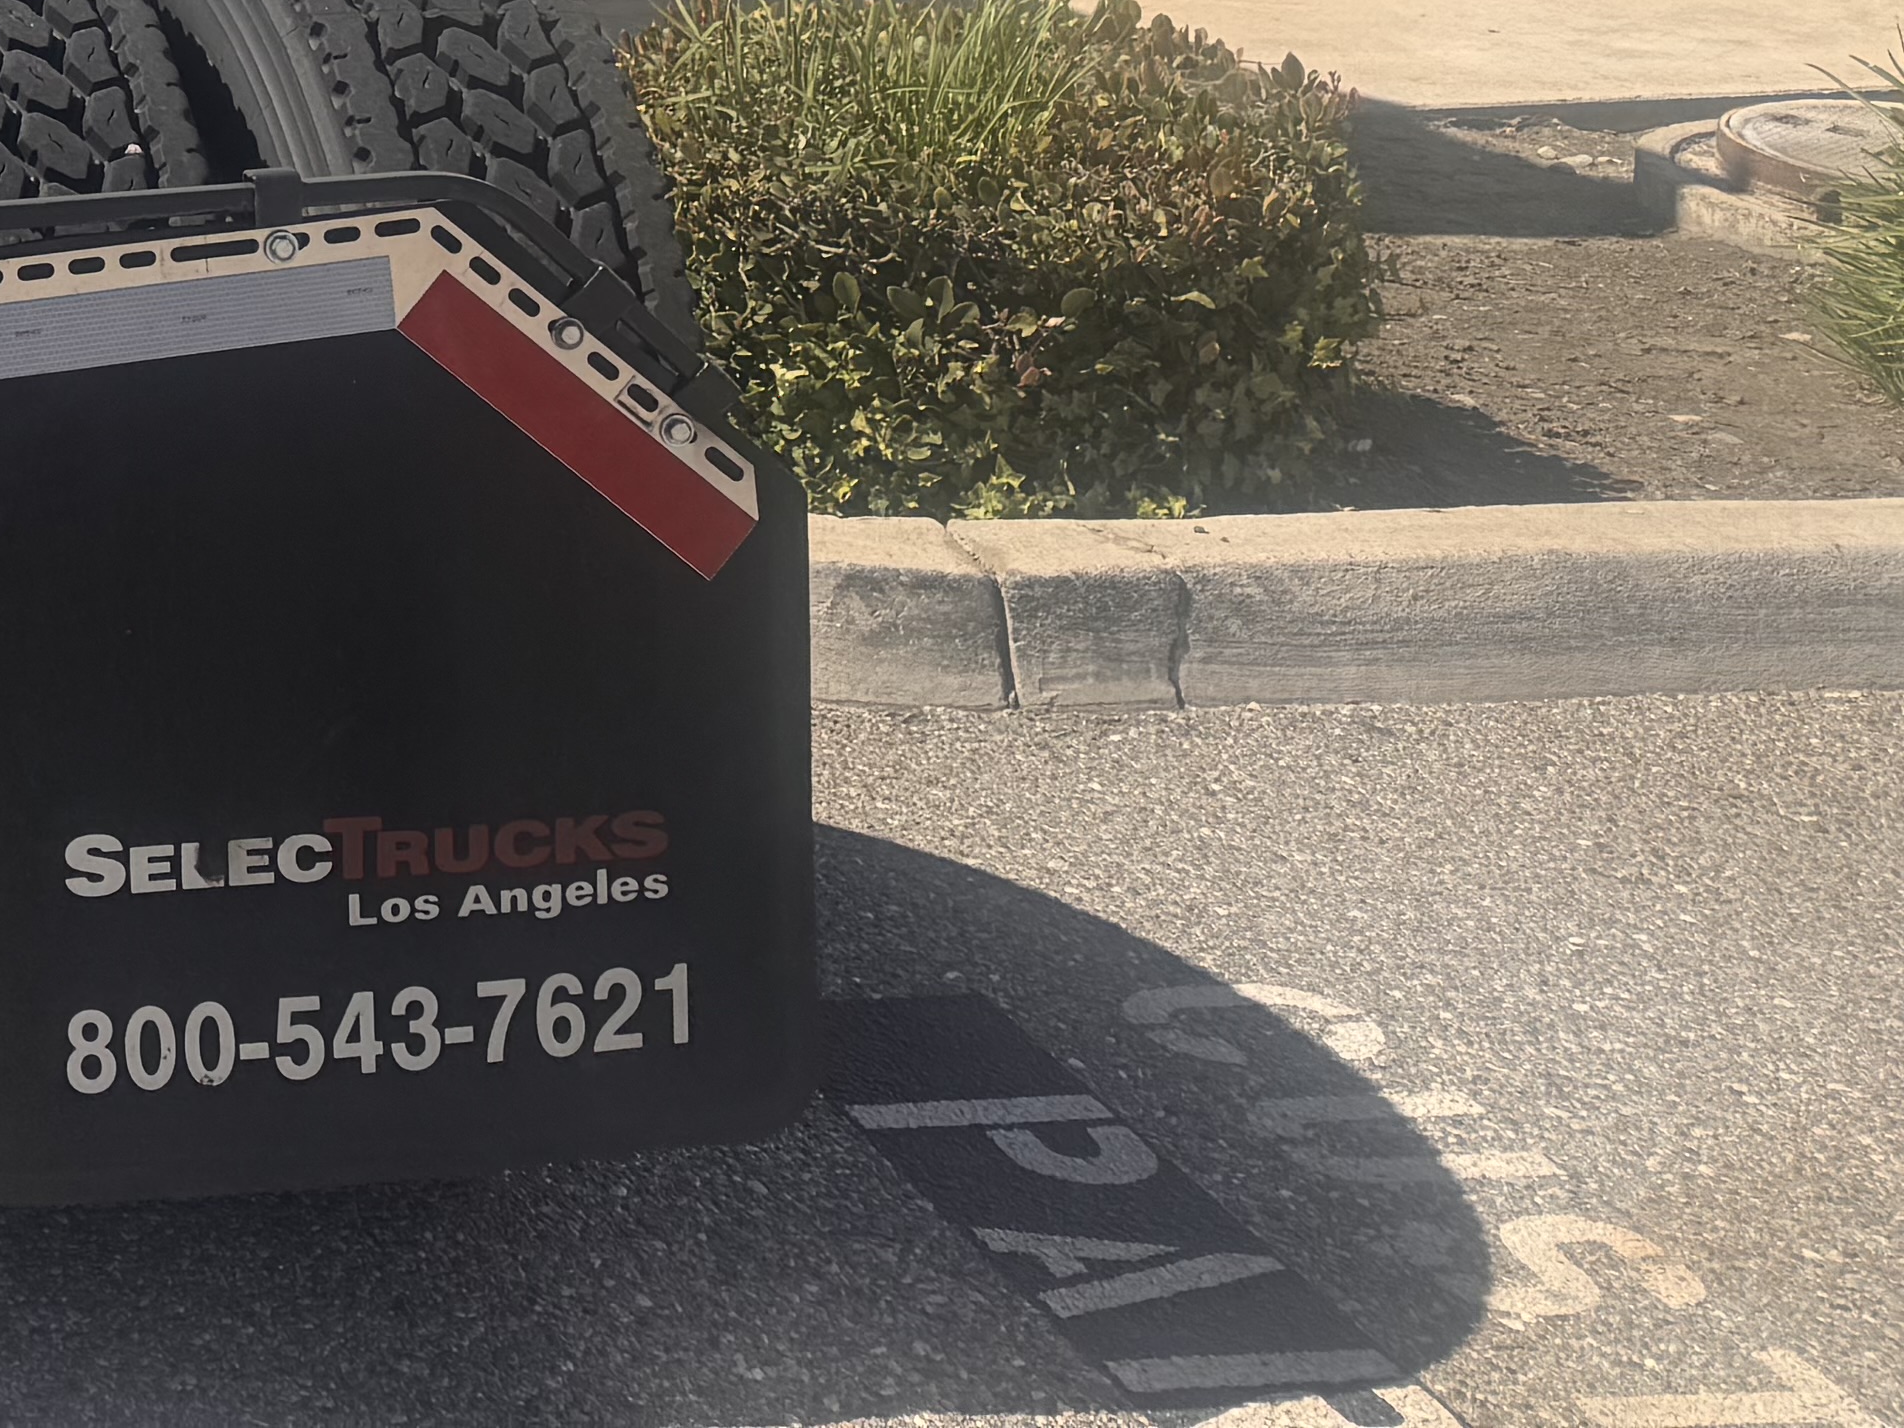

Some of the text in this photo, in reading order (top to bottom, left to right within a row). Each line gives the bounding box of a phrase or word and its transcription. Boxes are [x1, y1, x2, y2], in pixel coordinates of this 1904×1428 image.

[348, 869, 670, 926] Los Angeles
[65, 962, 693, 1095] 800-543-7621
